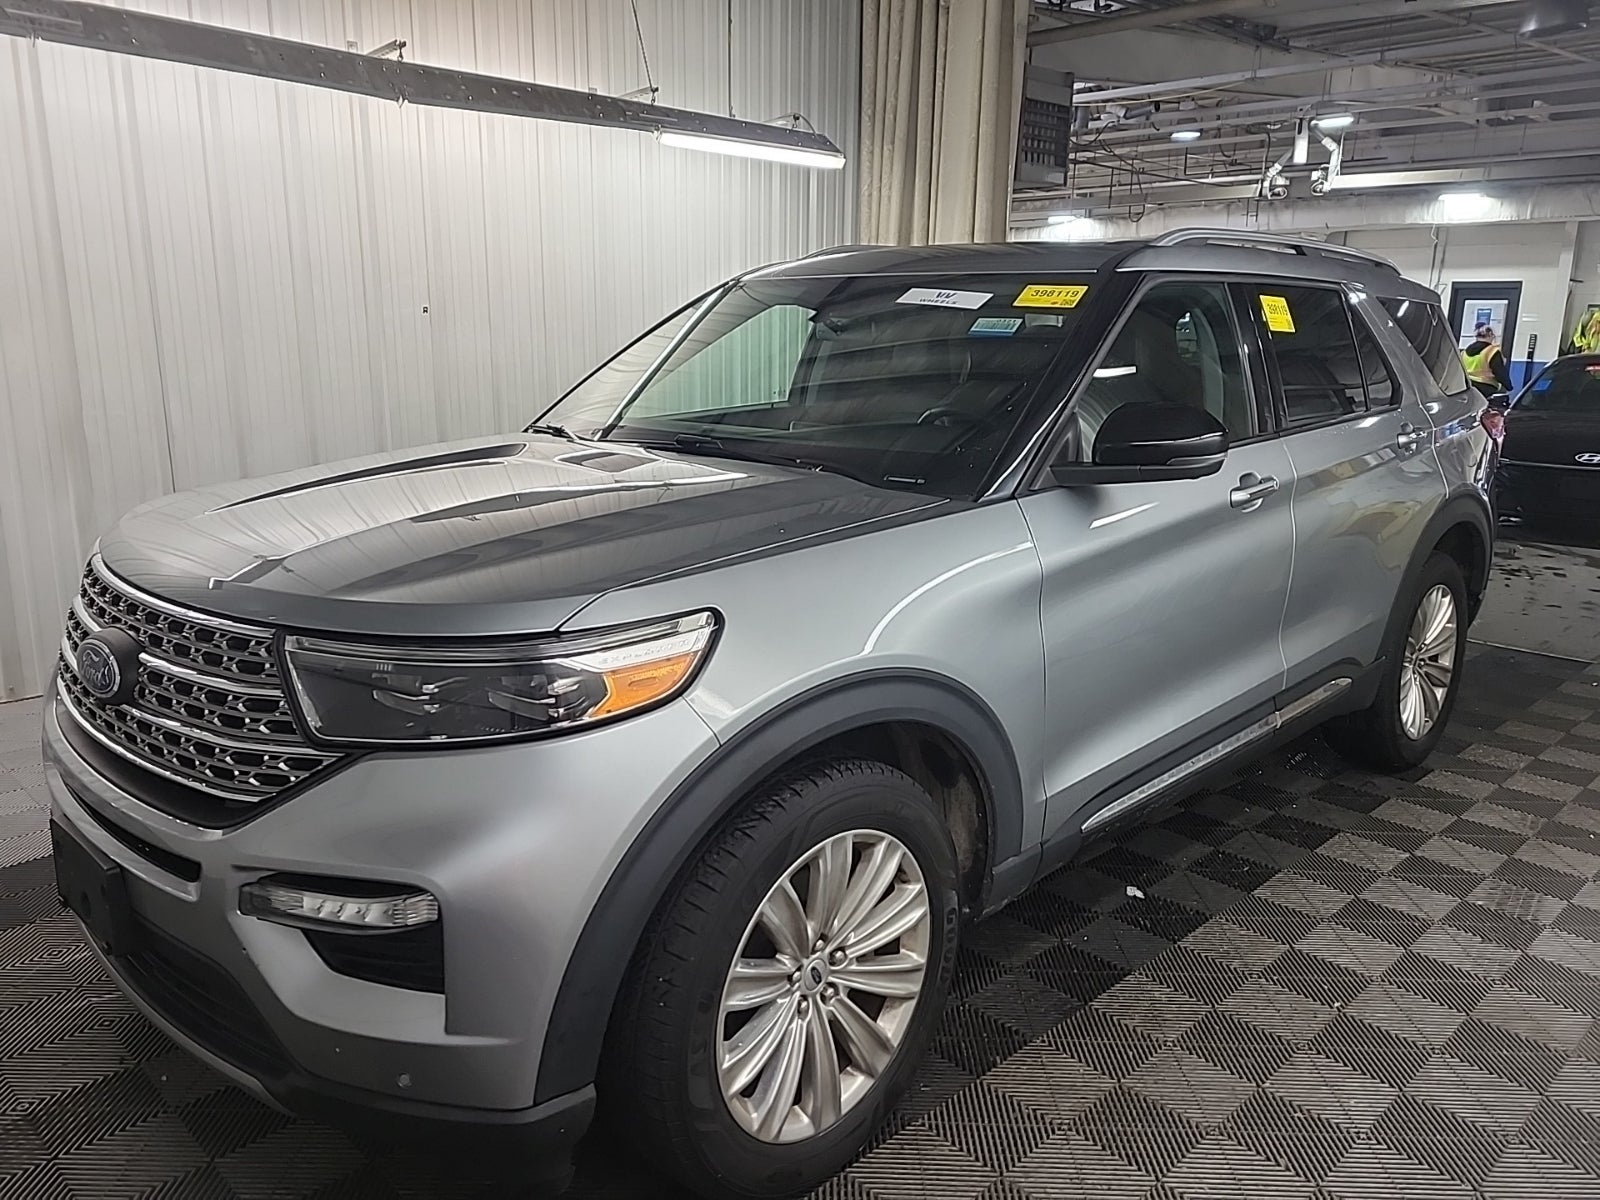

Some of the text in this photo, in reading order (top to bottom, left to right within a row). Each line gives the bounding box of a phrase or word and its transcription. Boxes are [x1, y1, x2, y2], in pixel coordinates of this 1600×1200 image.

[1031, 289, 1079, 298] 398119
[919, 297, 960, 305] WHEELS
[81, 650, 110, 687] Ford
